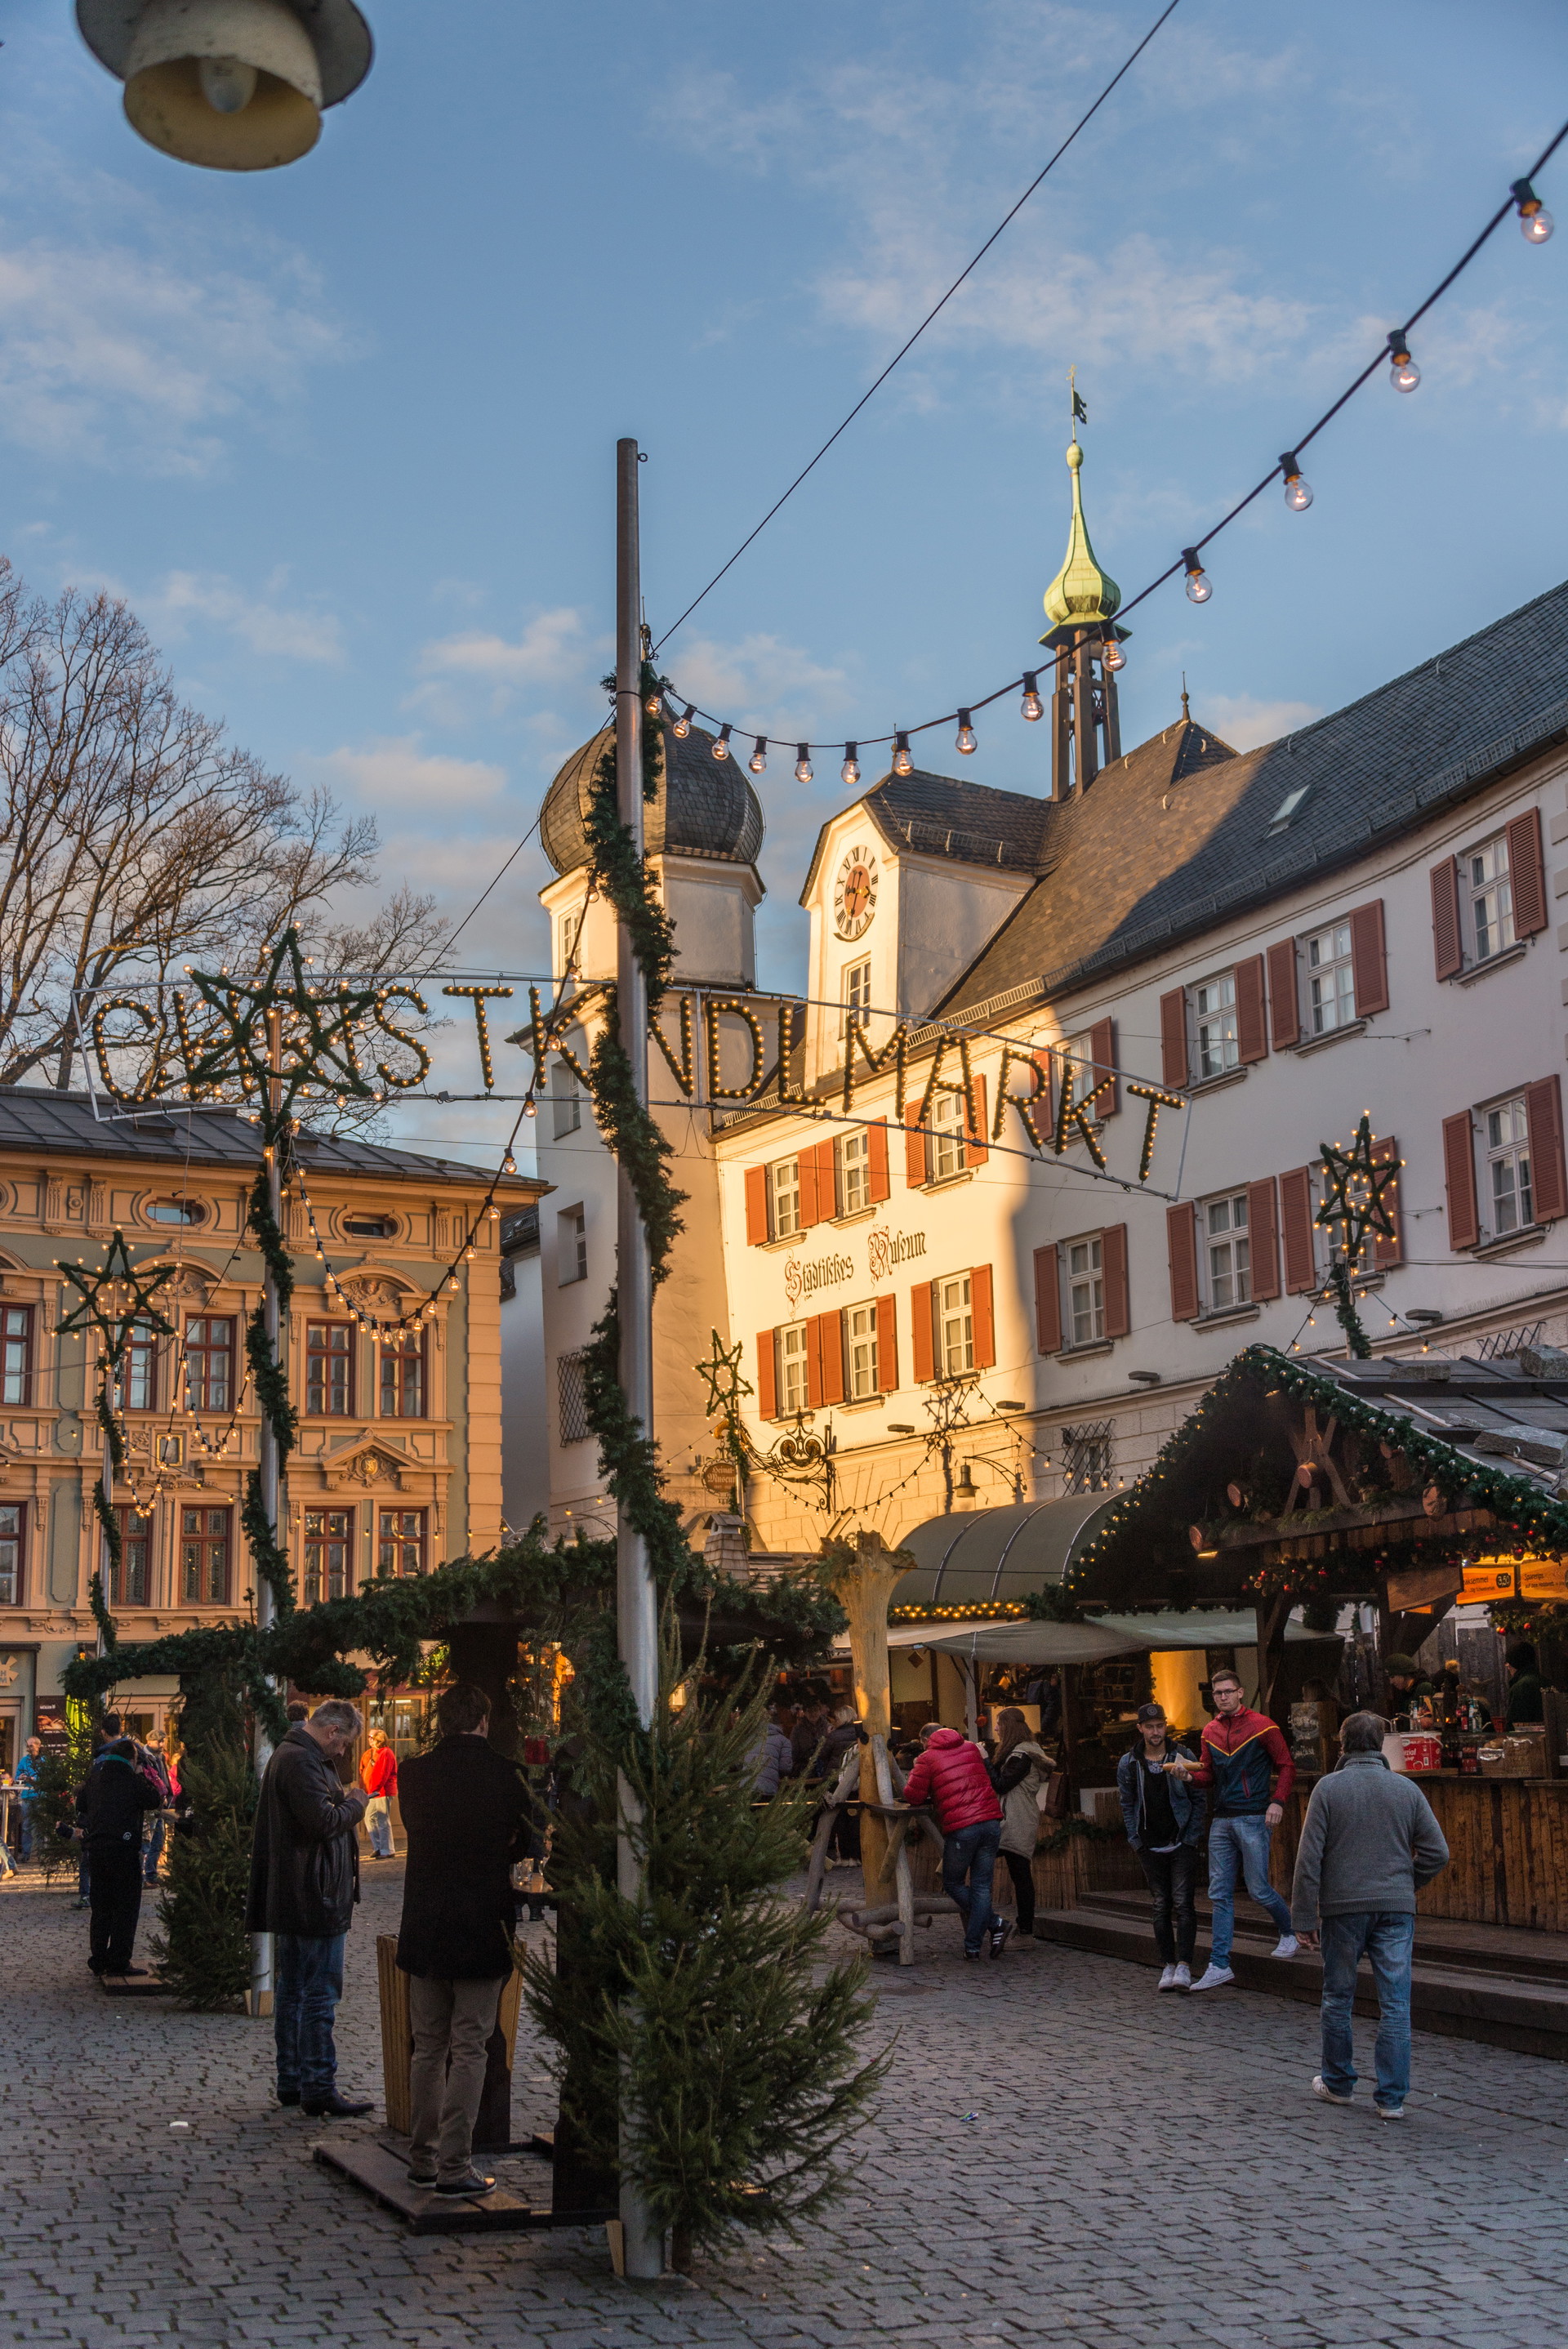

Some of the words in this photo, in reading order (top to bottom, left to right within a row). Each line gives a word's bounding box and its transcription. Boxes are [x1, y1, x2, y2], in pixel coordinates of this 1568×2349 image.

[92, 984, 1185, 1182] CHRISTKNDLMARKT
[867, 1225, 928, 1282] Museum
[1463, 1576, 1489, 1585] aksemmel
